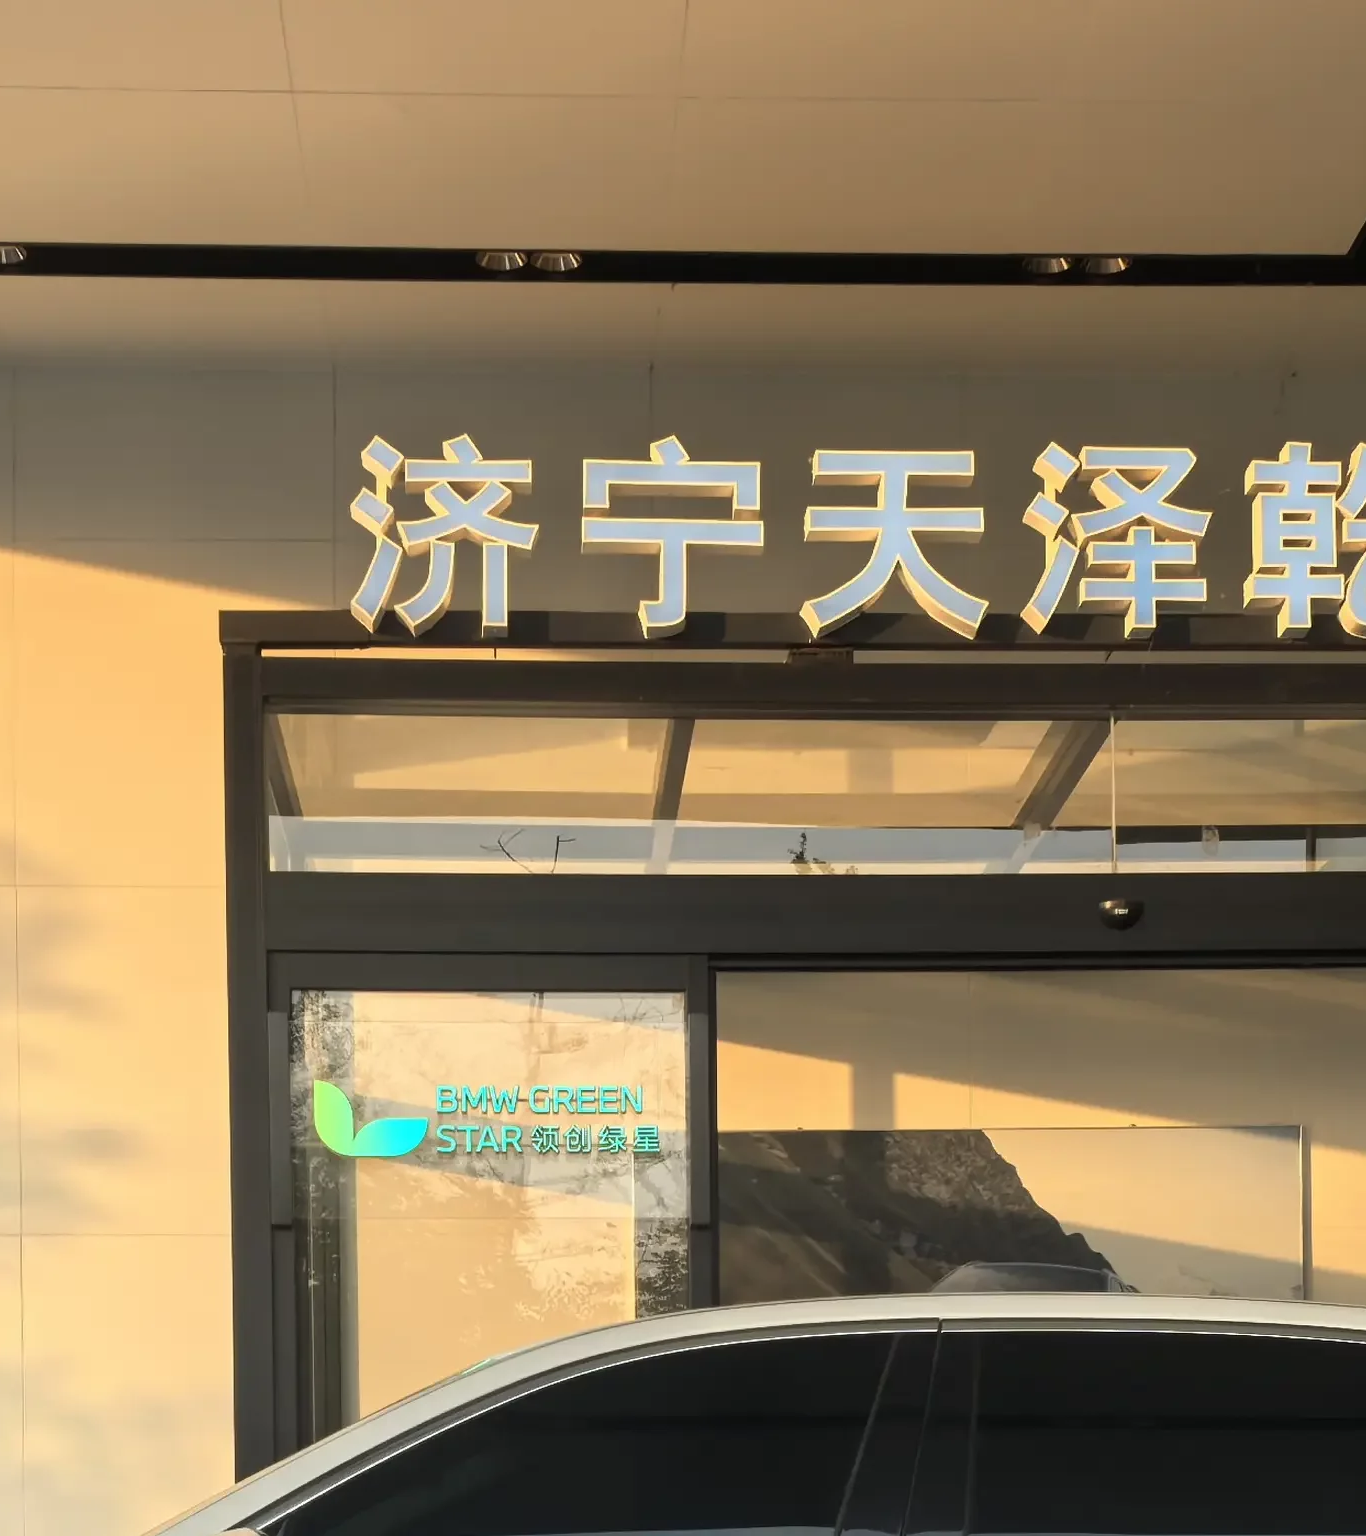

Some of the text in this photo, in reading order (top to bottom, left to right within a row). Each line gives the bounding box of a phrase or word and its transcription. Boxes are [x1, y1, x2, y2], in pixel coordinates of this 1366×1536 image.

[435, 1085, 644, 1114] BMW GREEN
[435, 1125, 661, 1154] STAR 领创绿星
